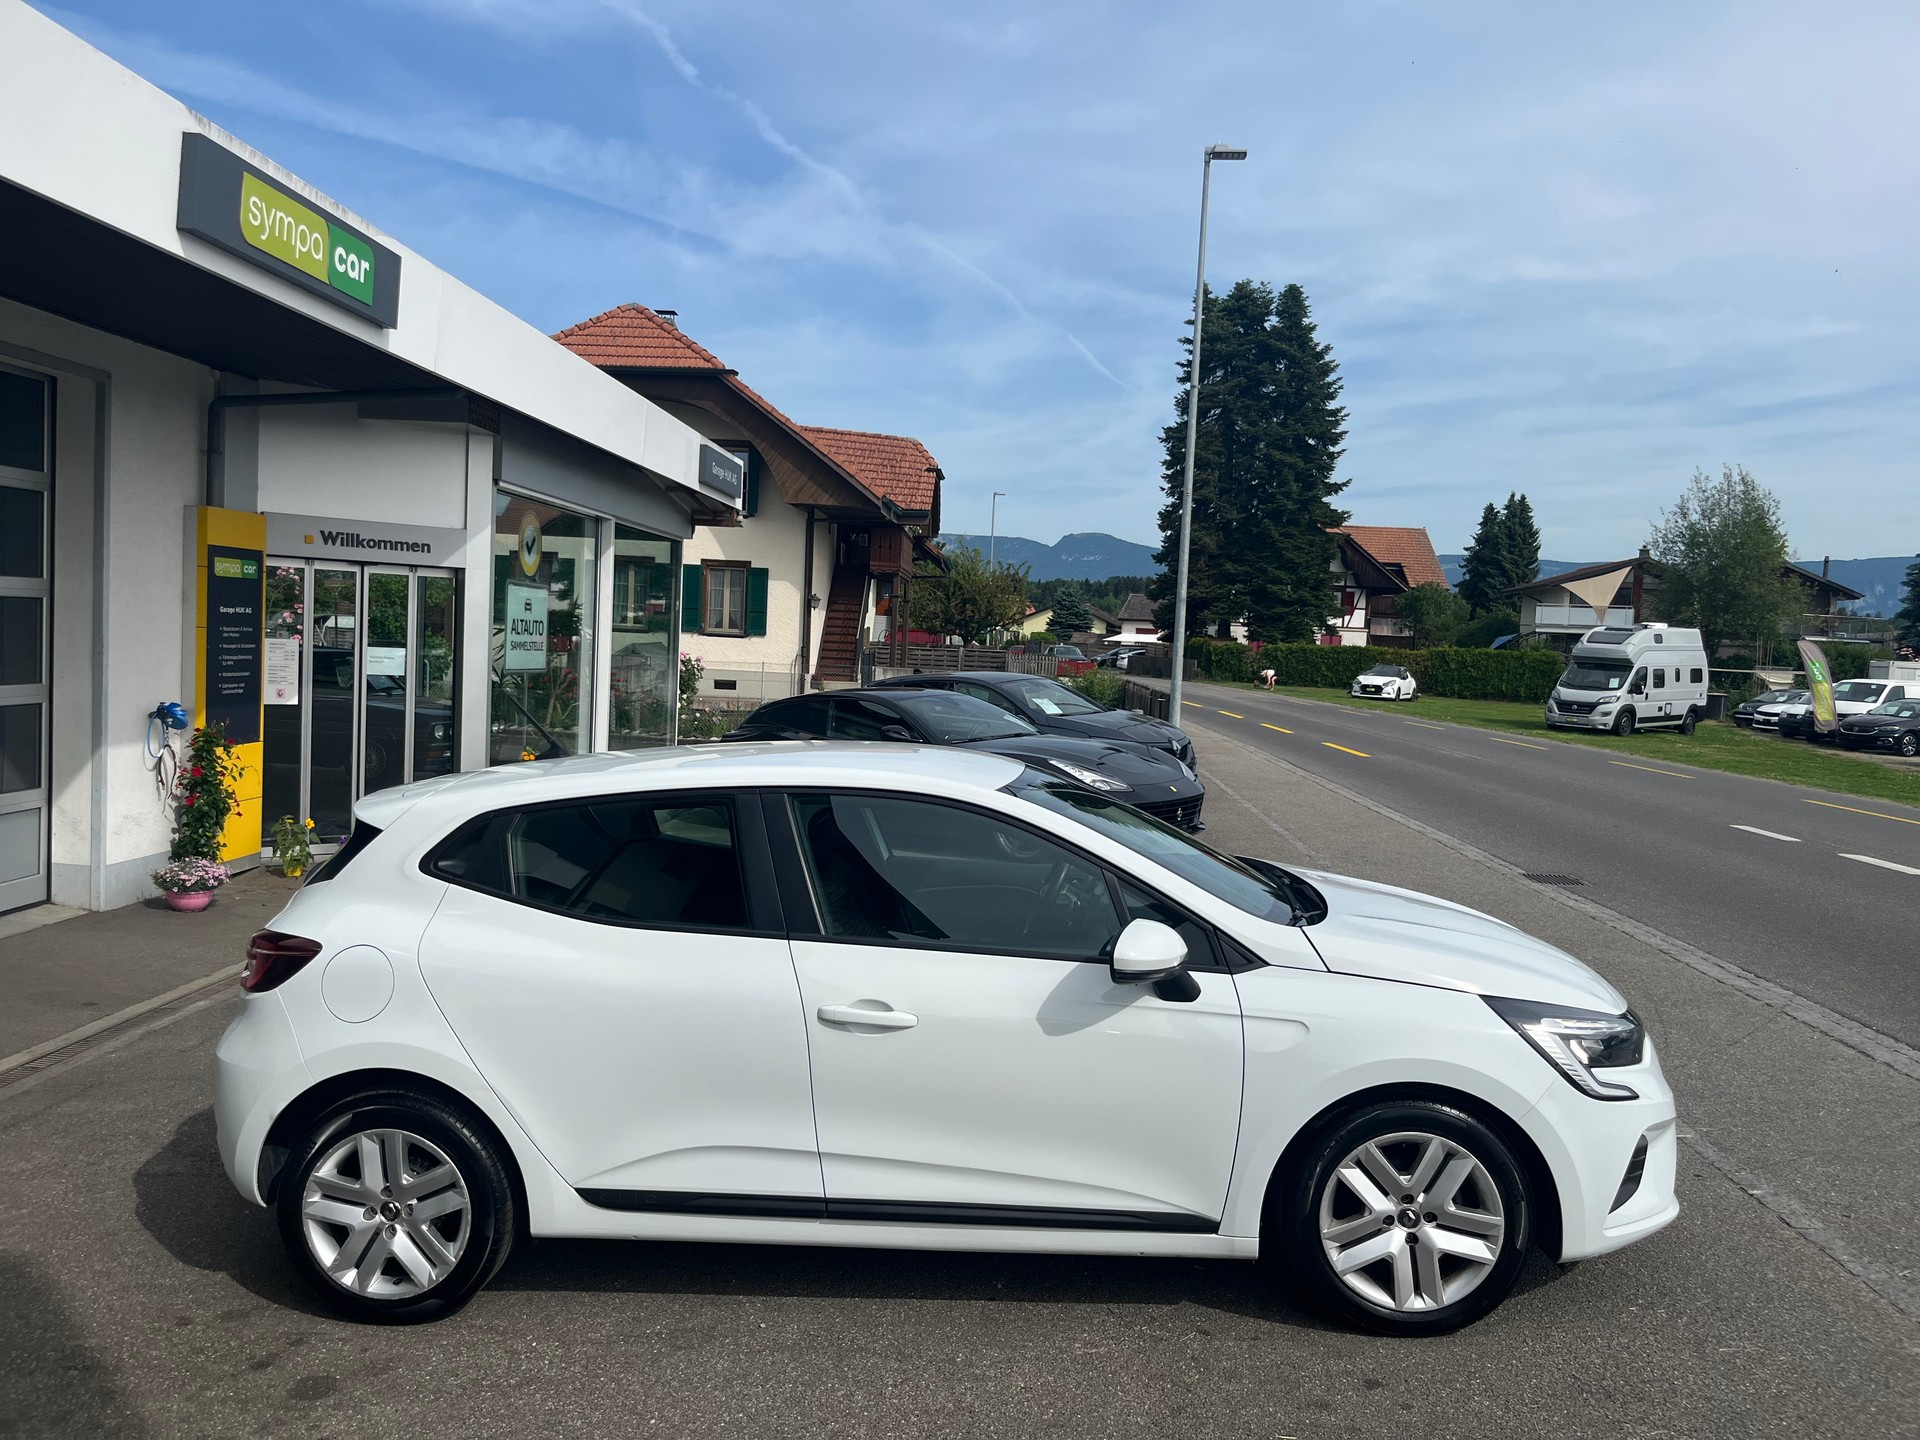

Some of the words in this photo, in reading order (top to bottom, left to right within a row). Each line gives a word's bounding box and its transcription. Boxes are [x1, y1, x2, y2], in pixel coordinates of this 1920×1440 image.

[249, 196, 324, 261] sympa
[334, 246, 370, 284] car
[319, 530, 432, 554] Willkommen
[216, 562, 240, 575] sympa
[243, 565, 257, 574] car
[219, 606, 235, 614] Garage
[510, 618, 544, 636] ALTAUTO
[510, 640, 544, 652] SAMMELSTELLE
